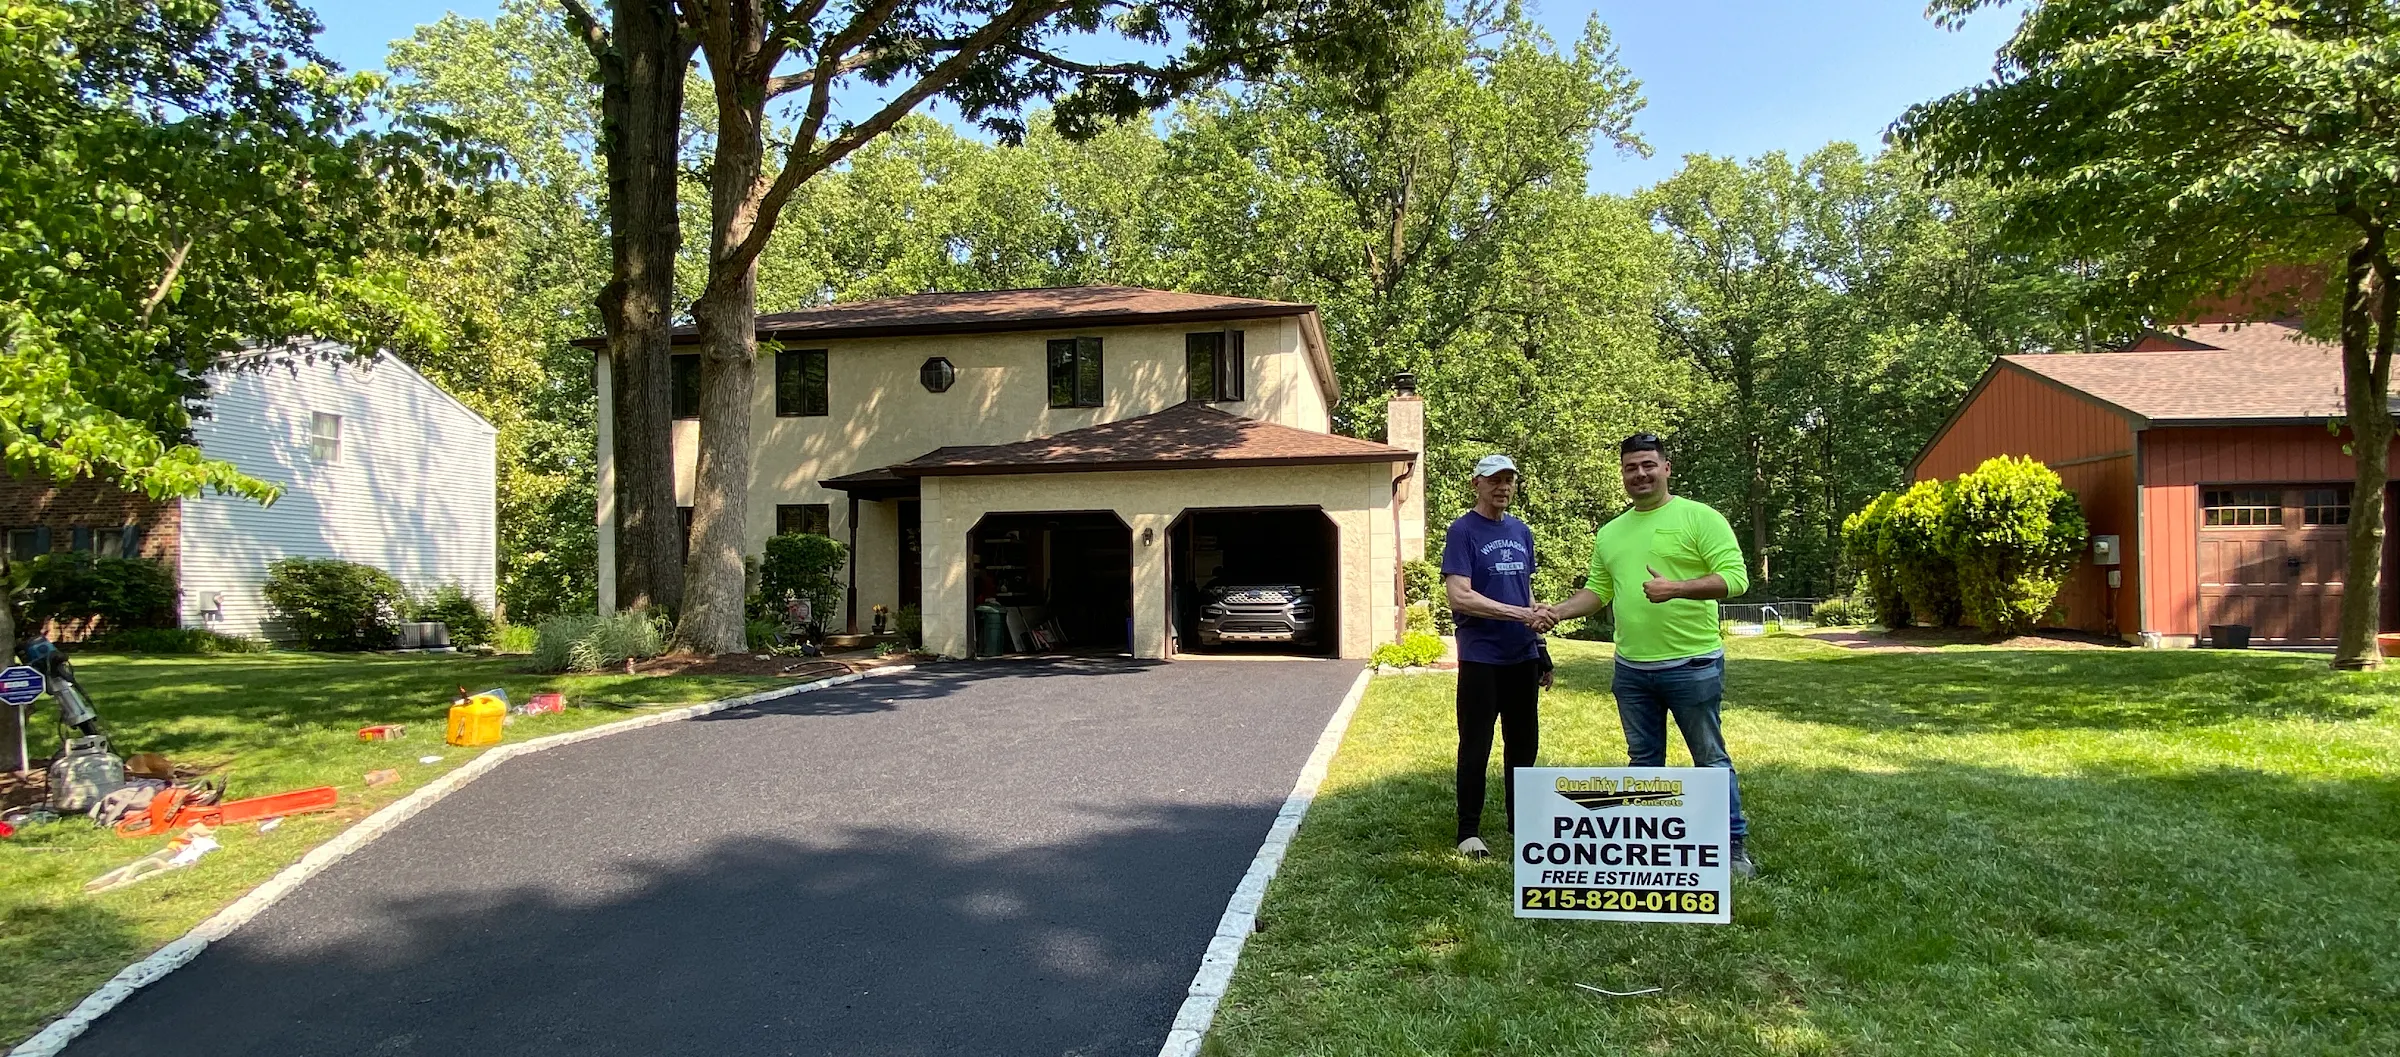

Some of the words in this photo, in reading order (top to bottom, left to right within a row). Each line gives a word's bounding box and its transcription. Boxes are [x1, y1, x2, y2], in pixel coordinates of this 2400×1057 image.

[1555, 777, 1618, 795] Quality
[1623, 777, 1682, 795] Paving
[1622, 798, 1630, 806] &
[1633, 798, 1683, 807] Concrete
[1554, 816, 1686, 839] PAVING
[1522, 842, 1719, 867] CONCRETE
[1541, 870, 1589, 884] FREE
[1594, 871, 1700, 886] ESTIMATES
[1526, 889, 1715, 912] 215-820-0168
